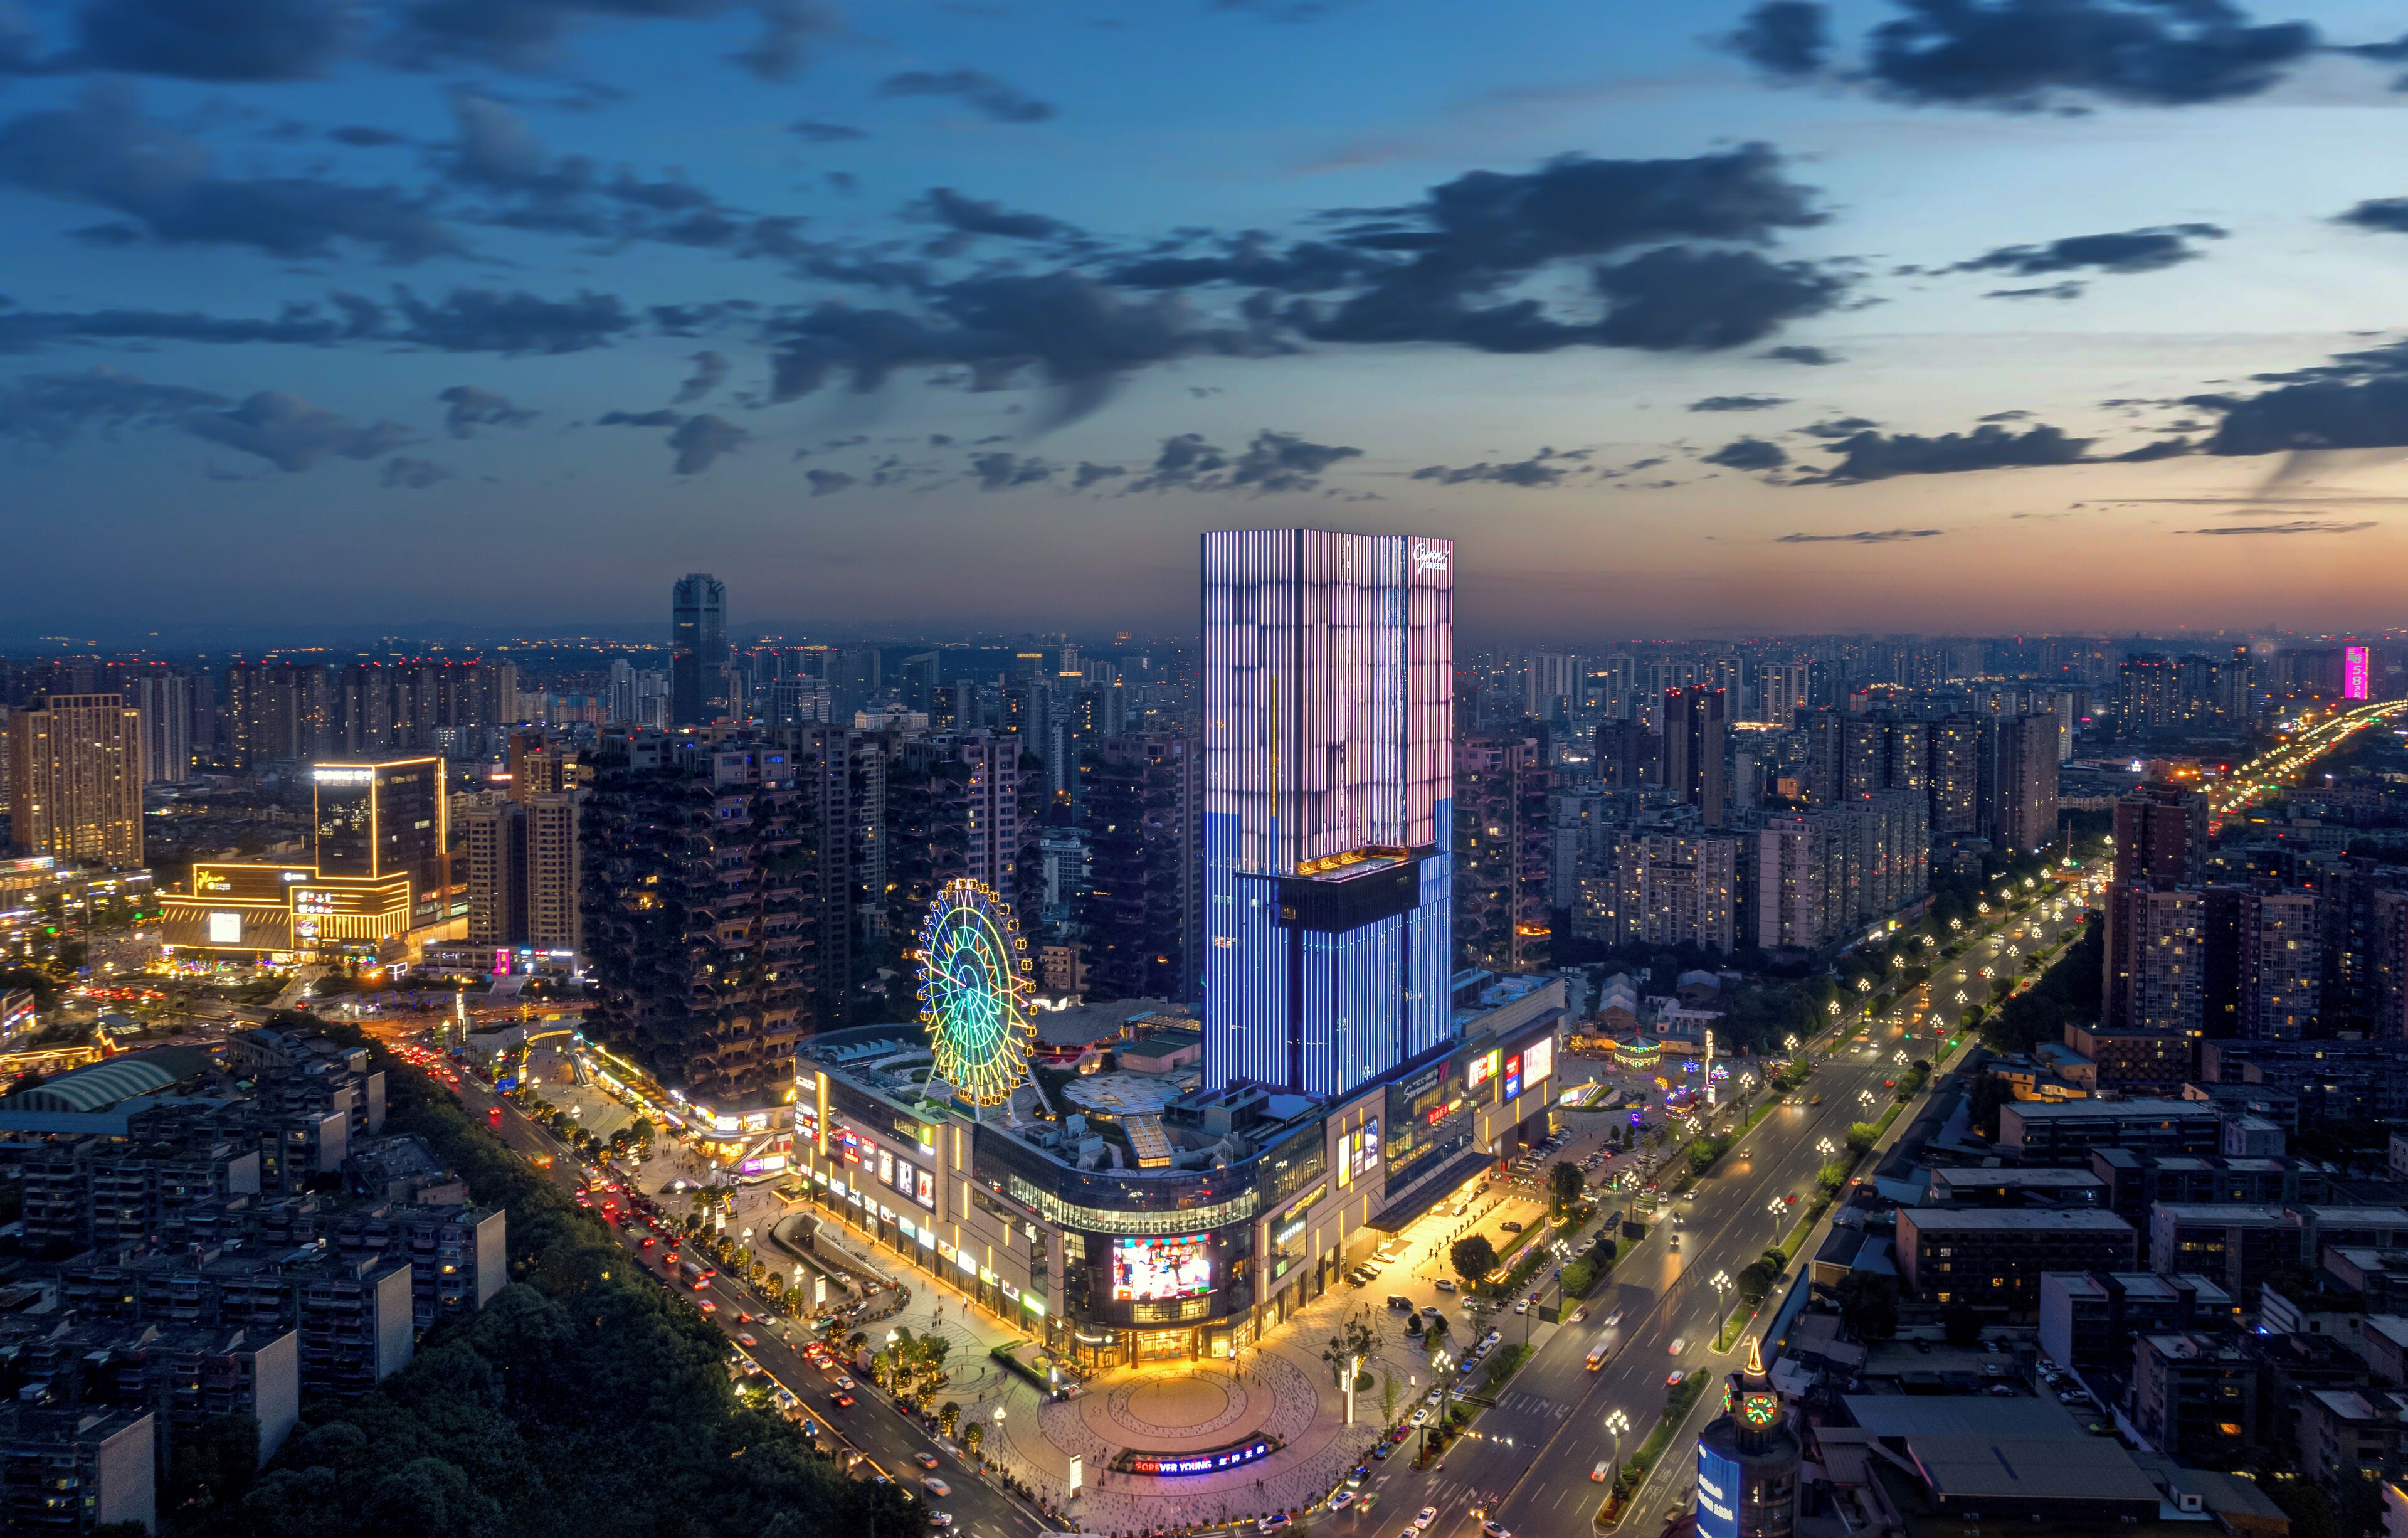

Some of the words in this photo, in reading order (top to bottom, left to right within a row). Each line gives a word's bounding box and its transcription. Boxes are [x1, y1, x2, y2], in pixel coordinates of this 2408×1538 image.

[1666, 1450, 1683, 1464] 40
[1136, 1461, 1177, 1472] FOREVER
[1180, 1460, 1212, 1471] YOUNG
